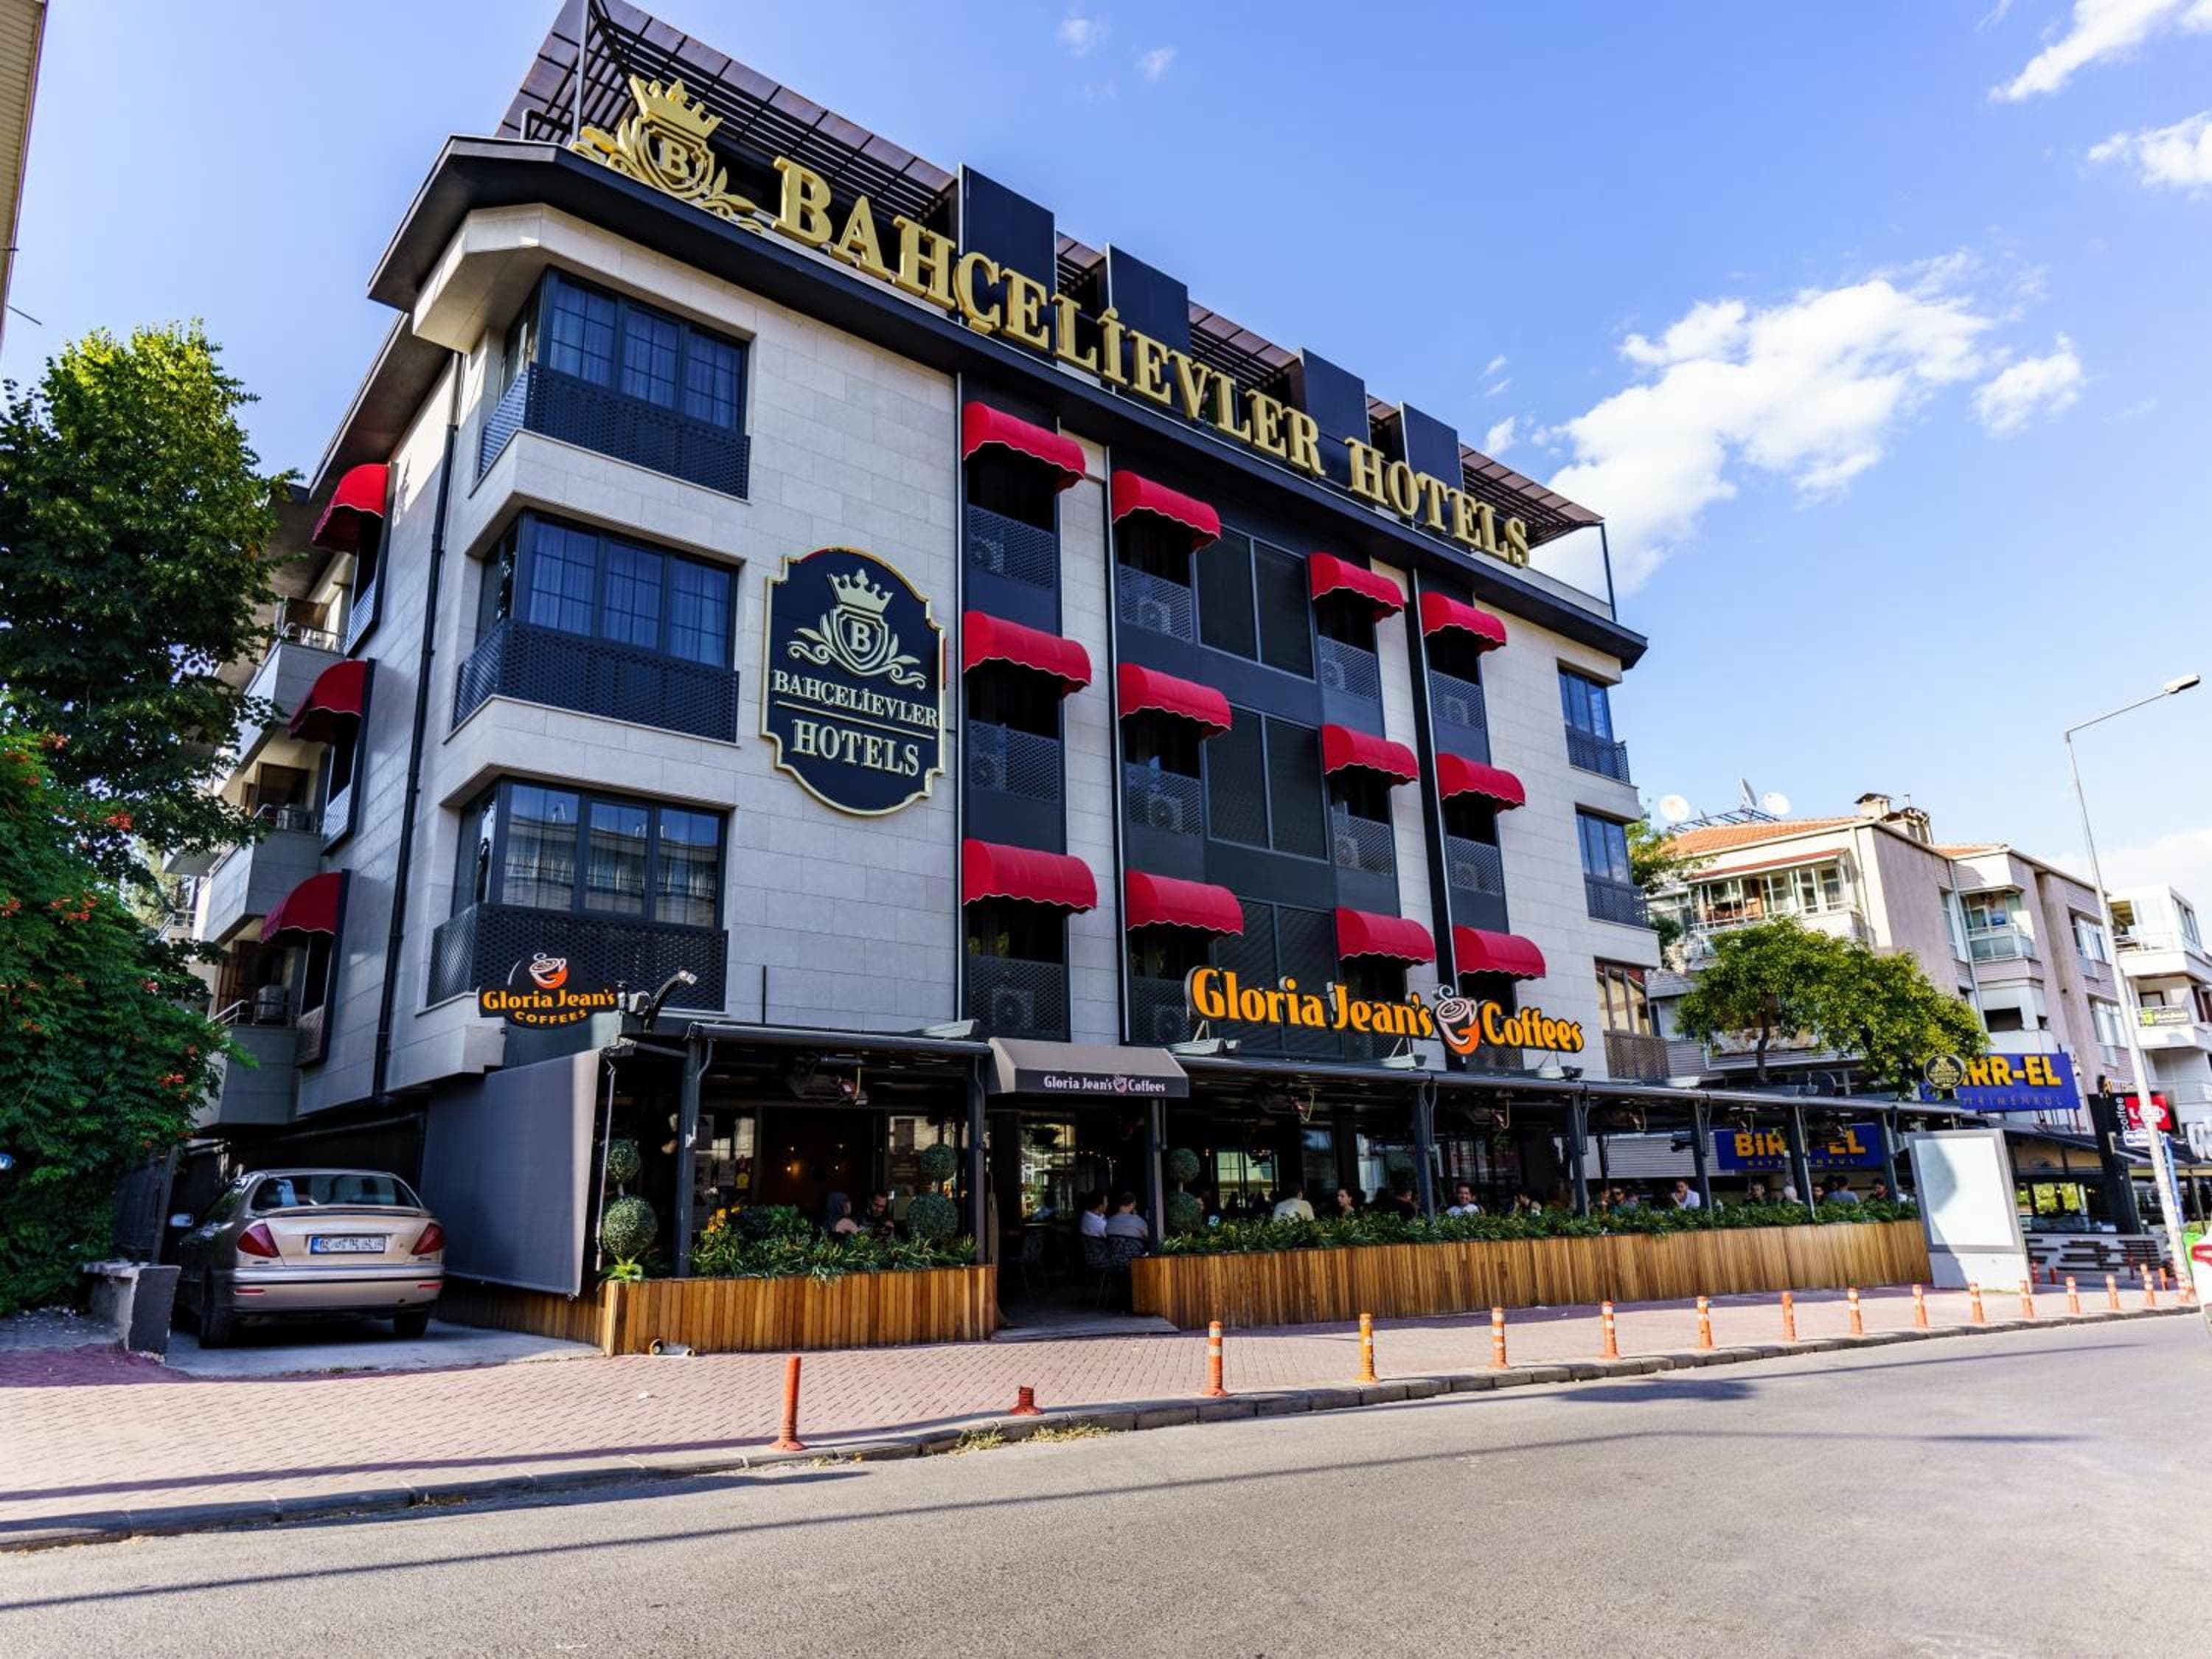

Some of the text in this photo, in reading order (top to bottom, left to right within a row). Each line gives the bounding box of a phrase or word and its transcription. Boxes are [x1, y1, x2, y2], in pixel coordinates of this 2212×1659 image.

[658, 133, 692, 181] B
[771, 155, 1531, 568] BAHÇELİEVLER HOTELS
[849, 619, 872, 653] B
[772, 669, 939, 729] BAHÇELİEVLER
[791, 718, 920, 776] HOTELS
[483, 989, 615, 1009] Gloria Jean's
[514, 1009, 588, 1024] COFFEES
[1186, 965, 1584, 1052] Gloria Jean's Coffees
[1043, 1075, 1166, 1093] Gloria Jean's Coffees
[1961, 1055, 2062, 1086] RR-EL
